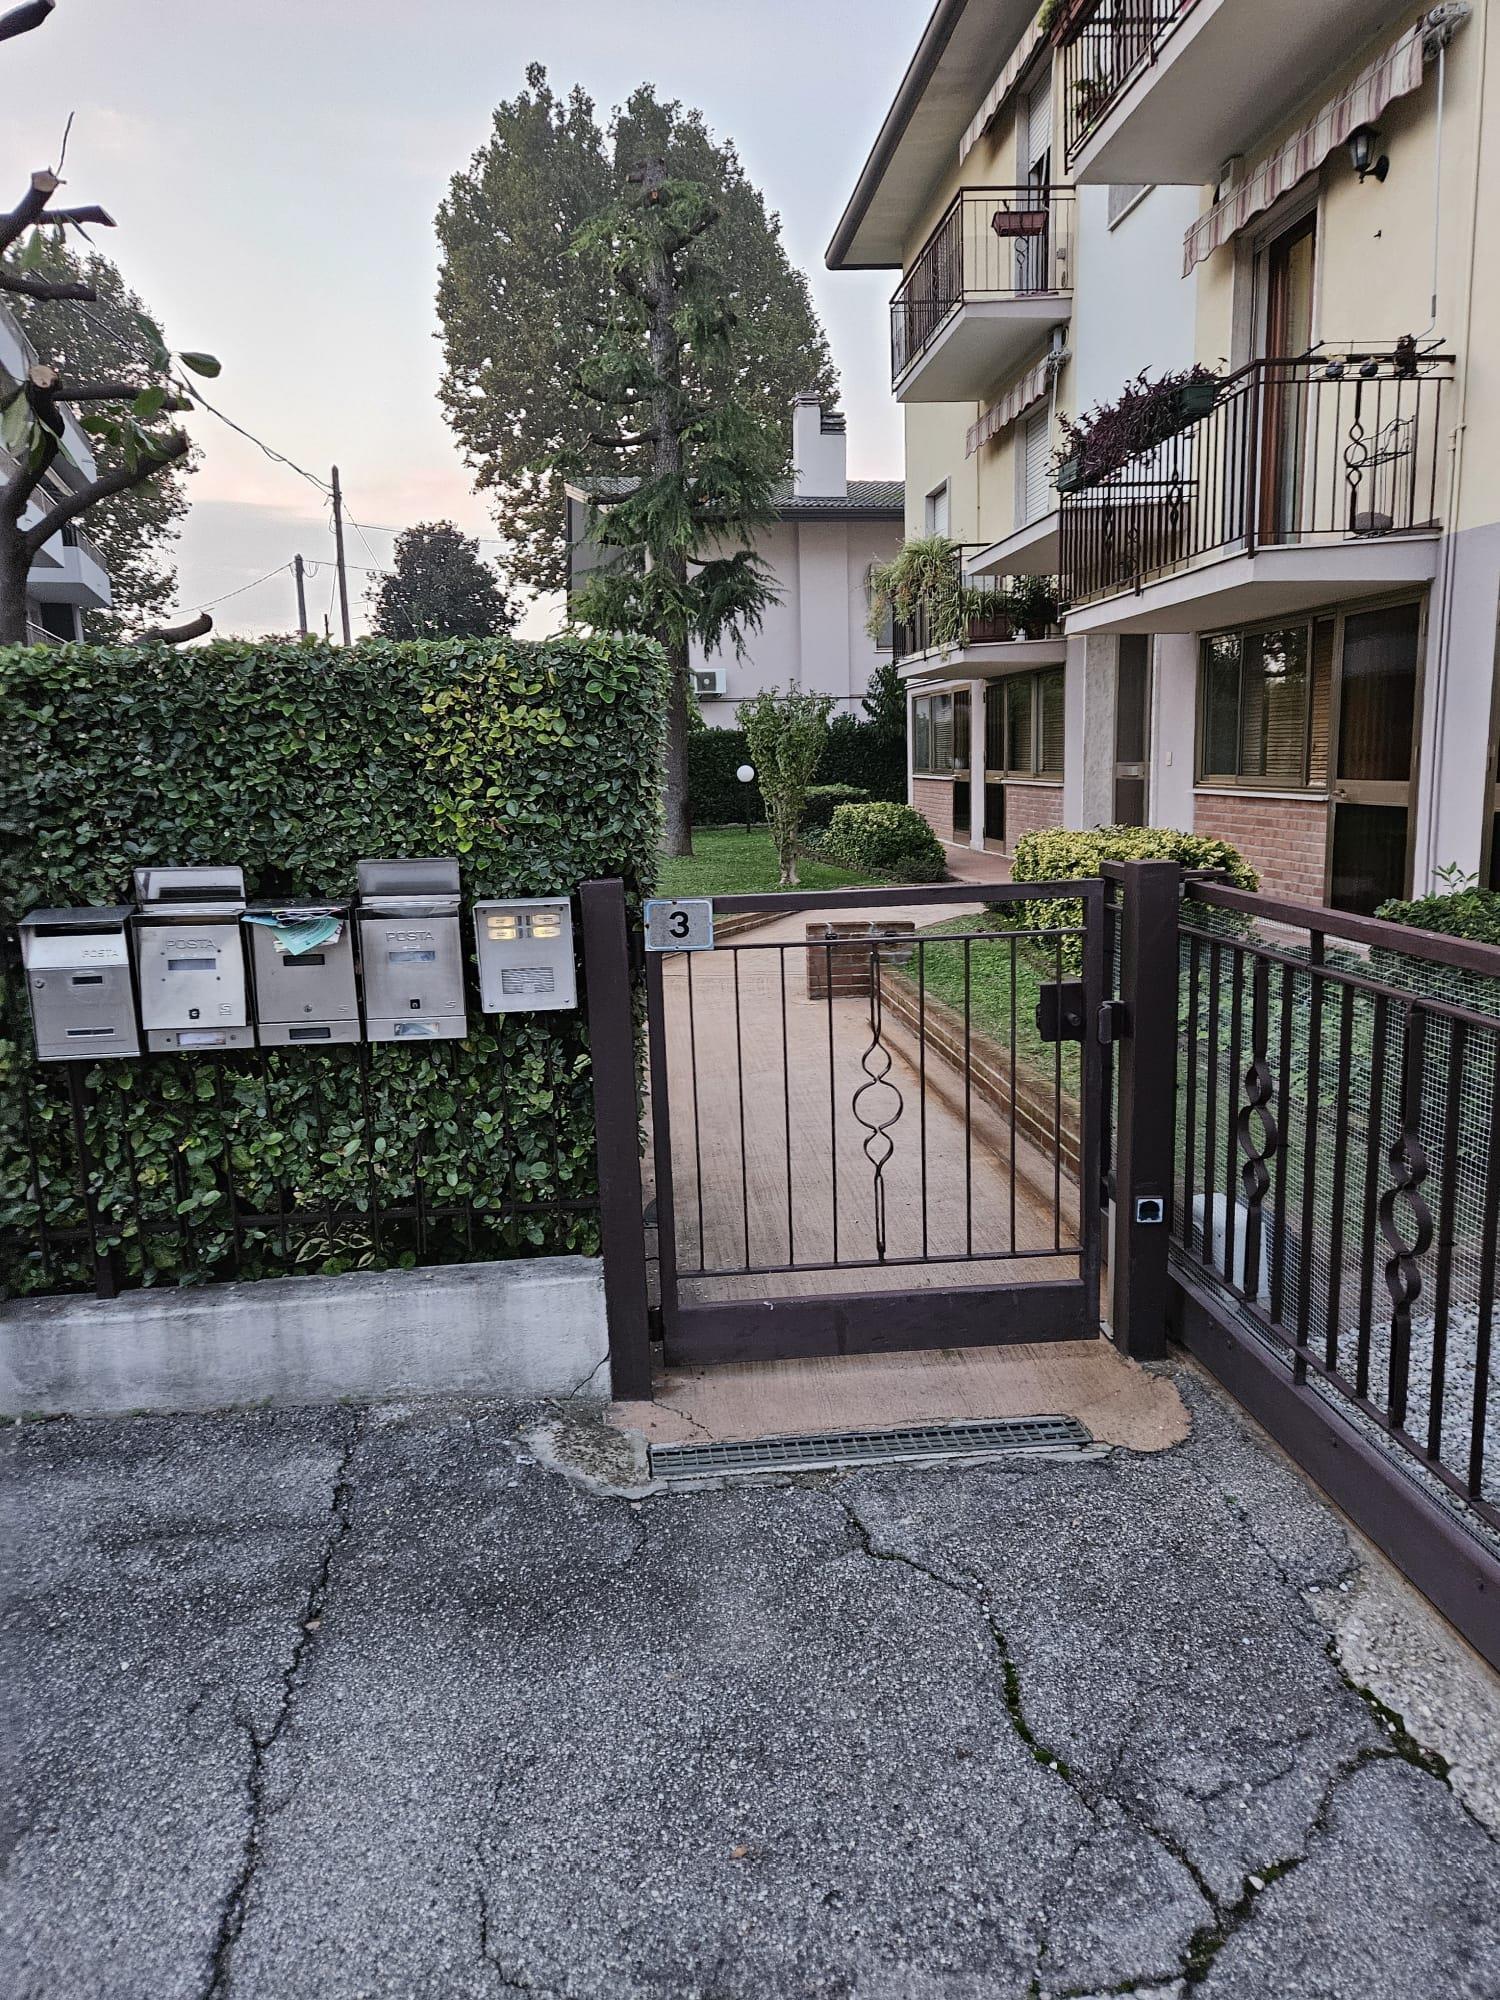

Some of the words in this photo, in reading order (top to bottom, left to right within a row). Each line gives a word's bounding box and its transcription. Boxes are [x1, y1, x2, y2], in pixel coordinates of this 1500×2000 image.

[669, 910, 690, 939] 3
[386, 930, 435, 942] POSTA
[165, 937, 216, 950] POSTA
[81, 948, 119, 959] POSTA
